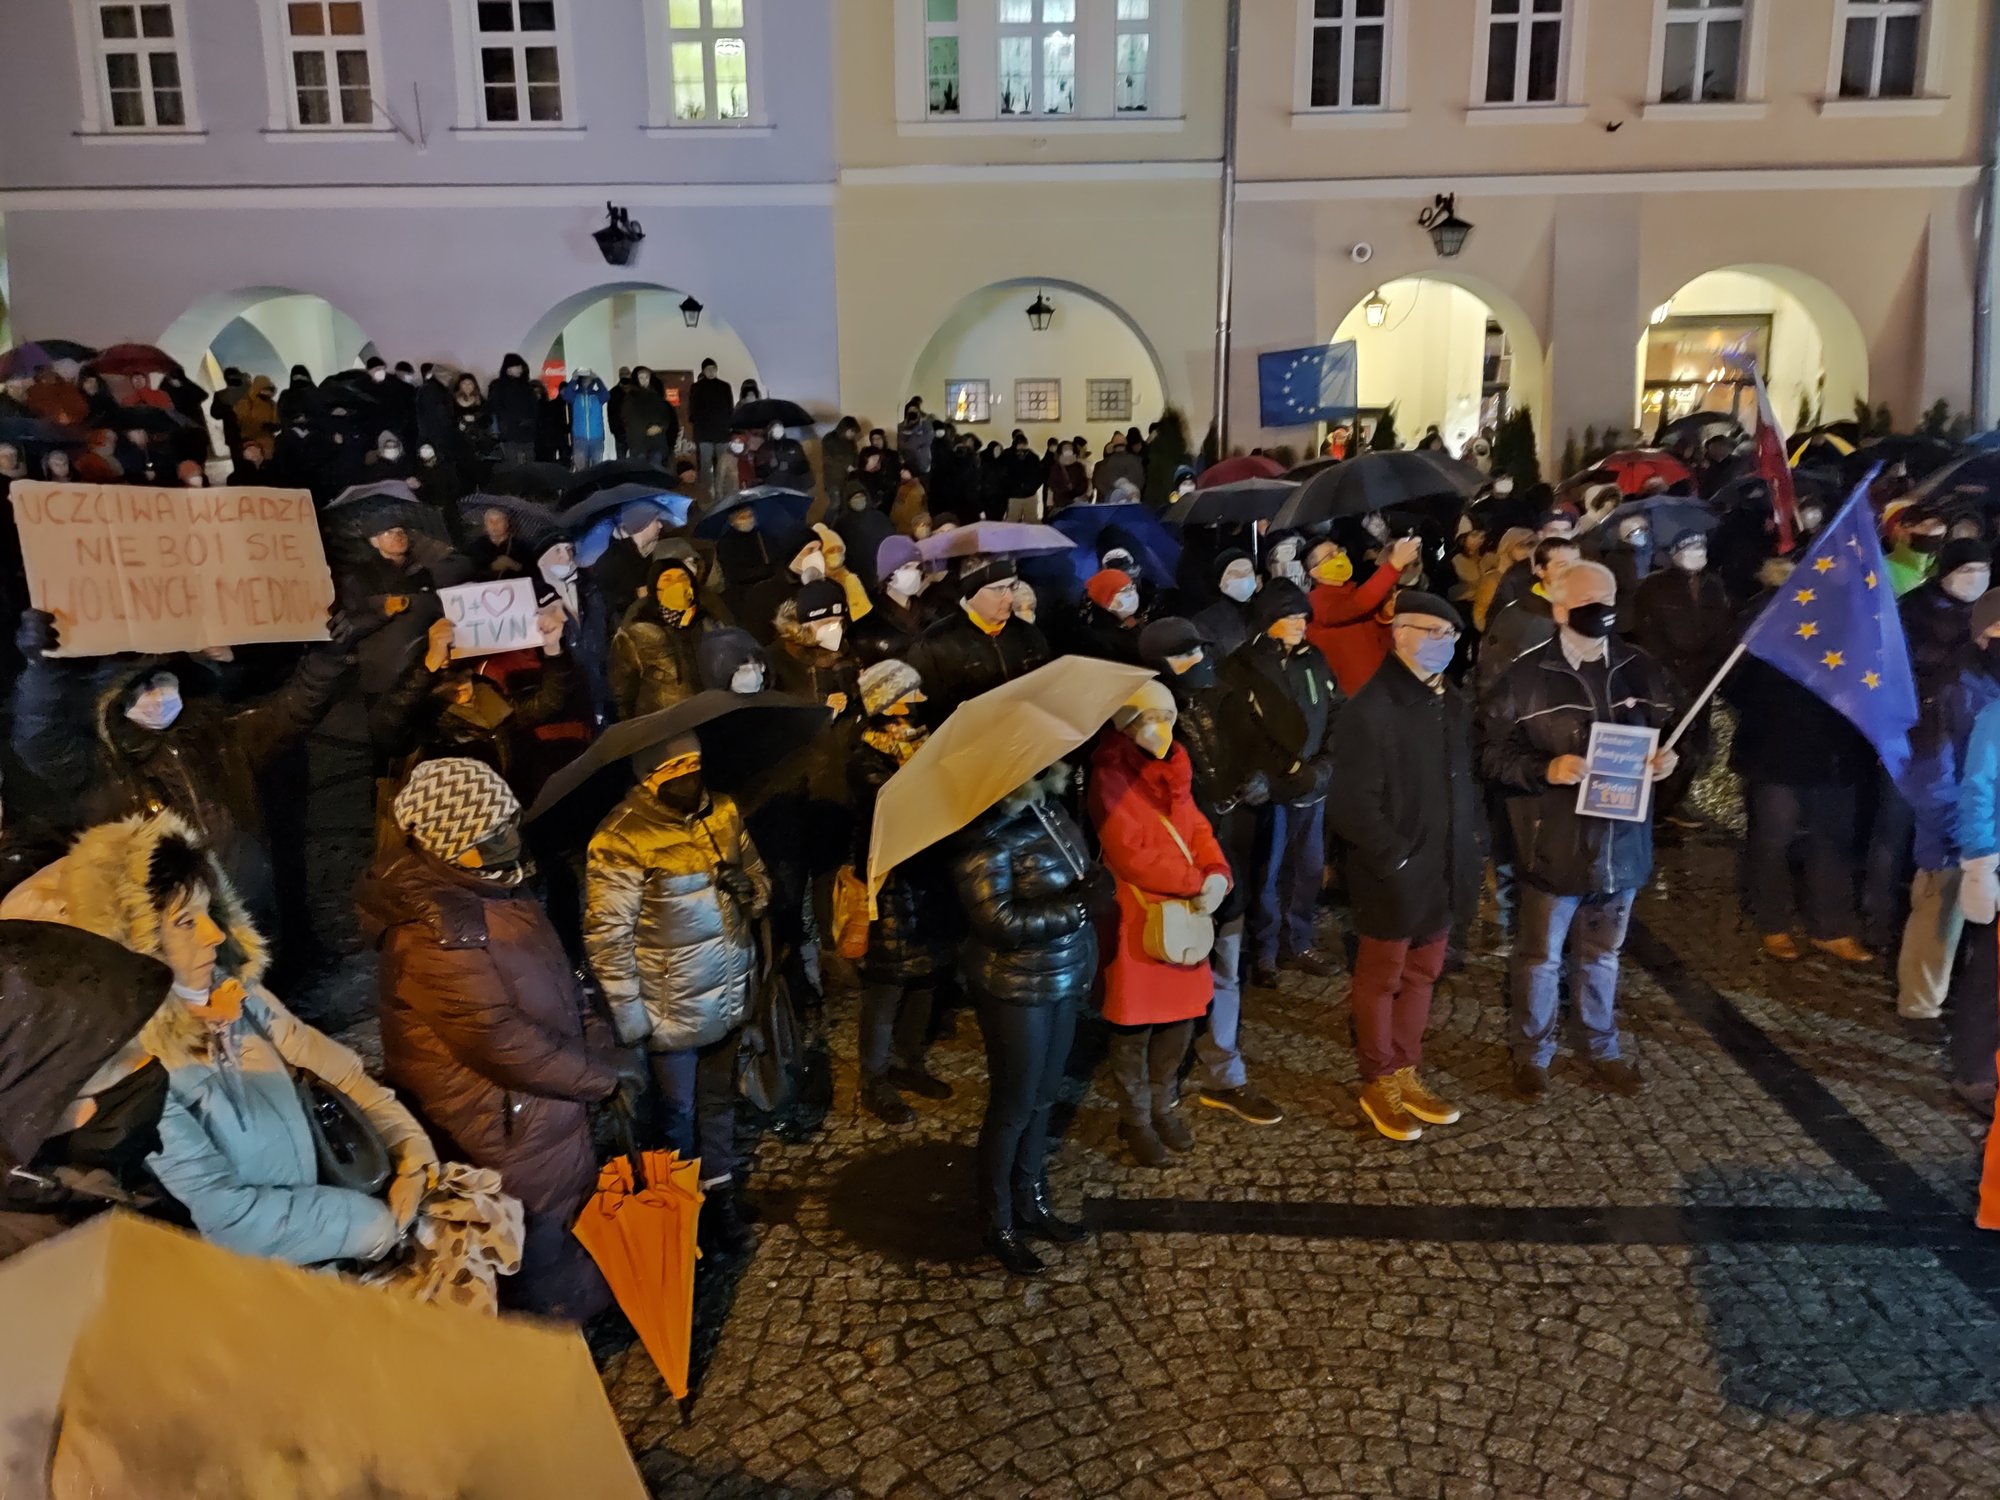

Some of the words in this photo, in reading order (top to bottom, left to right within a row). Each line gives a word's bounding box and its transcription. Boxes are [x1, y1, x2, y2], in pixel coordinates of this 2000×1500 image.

[19, 491, 176, 524] UCZCIWA
[189, 495, 314, 524] WŁADZA
[76, 536, 146, 567] NIE
[159, 533, 224, 567] BOI
[246, 532, 305, 568] SIĘ
[41, 576, 199, 626] WOLNYCH
[465, 613, 528, 648] TVN
